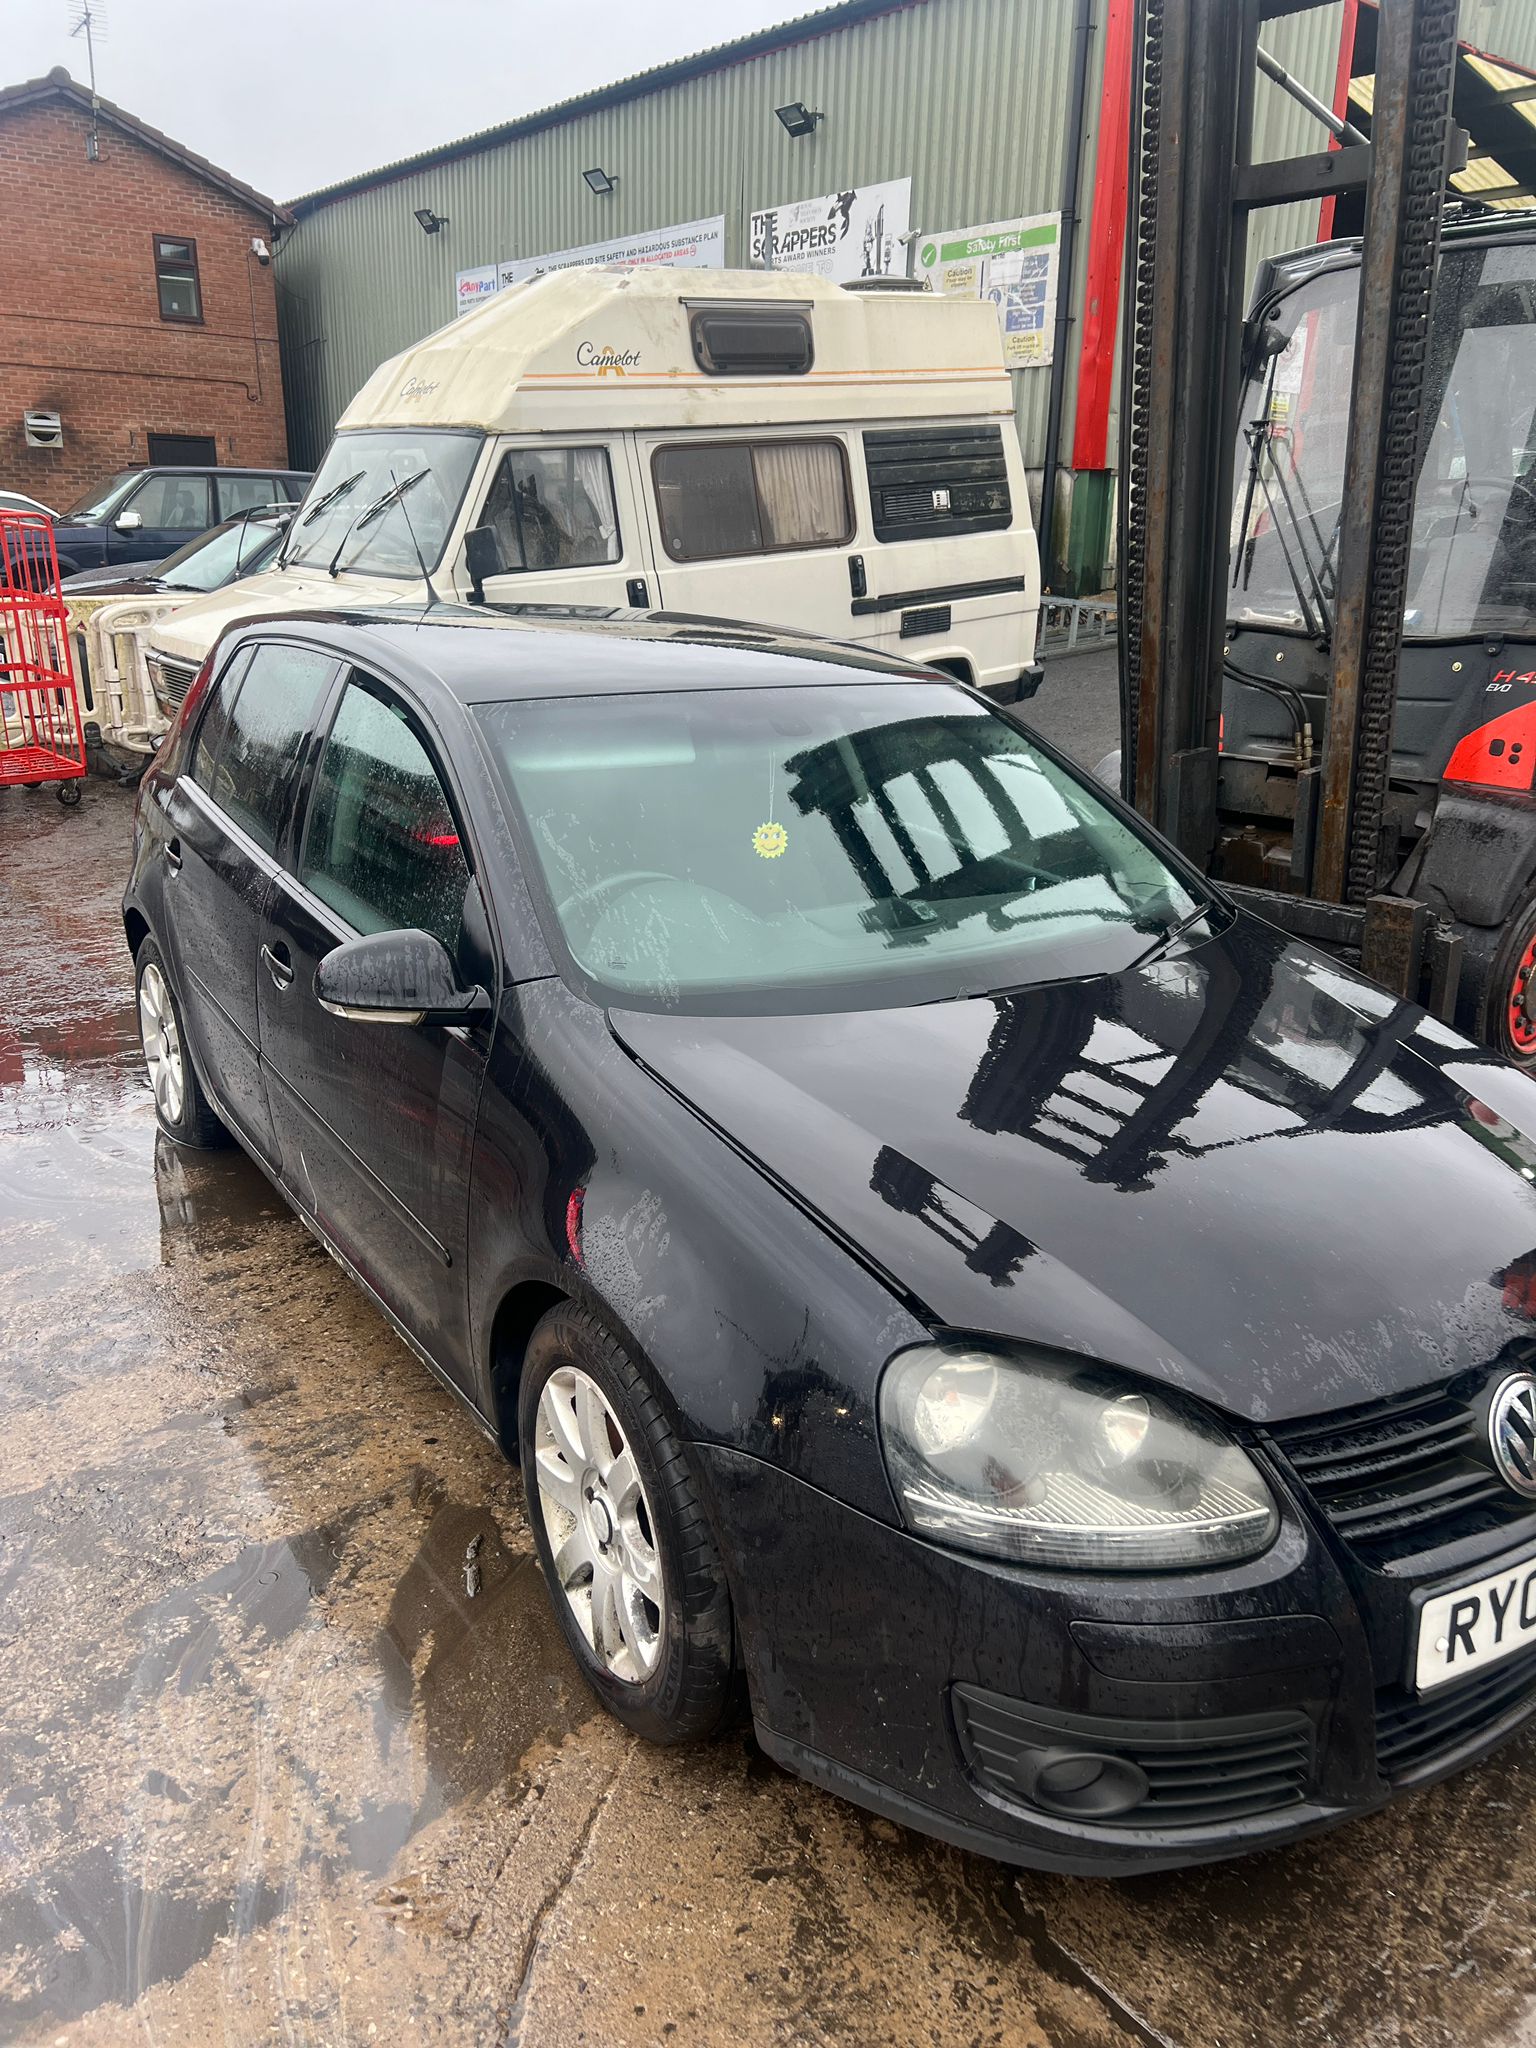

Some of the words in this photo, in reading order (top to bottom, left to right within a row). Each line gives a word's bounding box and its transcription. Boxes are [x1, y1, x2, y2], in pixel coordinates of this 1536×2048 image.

[594, 255, 606, 264] SITE
[606, 250, 625, 262] SAFETY
[626, 248, 637, 257] AND
[638, 242, 670, 255] HAZARDOUS
[671, 234, 702, 248] SUBSTANCE
[703, 231, 718, 242] PLAN
[783, 252, 805, 263] AWARD
[806, 247, 836, 259] WINNERS
[646, 251, 673, 263] ALLOCATED
[674, 248, 690, 257] AREAS
[502, 272, 513, 284] THE
[466, 279, 495, 293] AnyPart
[576, 341, 642, 367] Camelot
[400, 377, 440, 398] Camelot
[1516, 671, 1536, 684] 4
[1485, 683, 1513, 693] EVO
